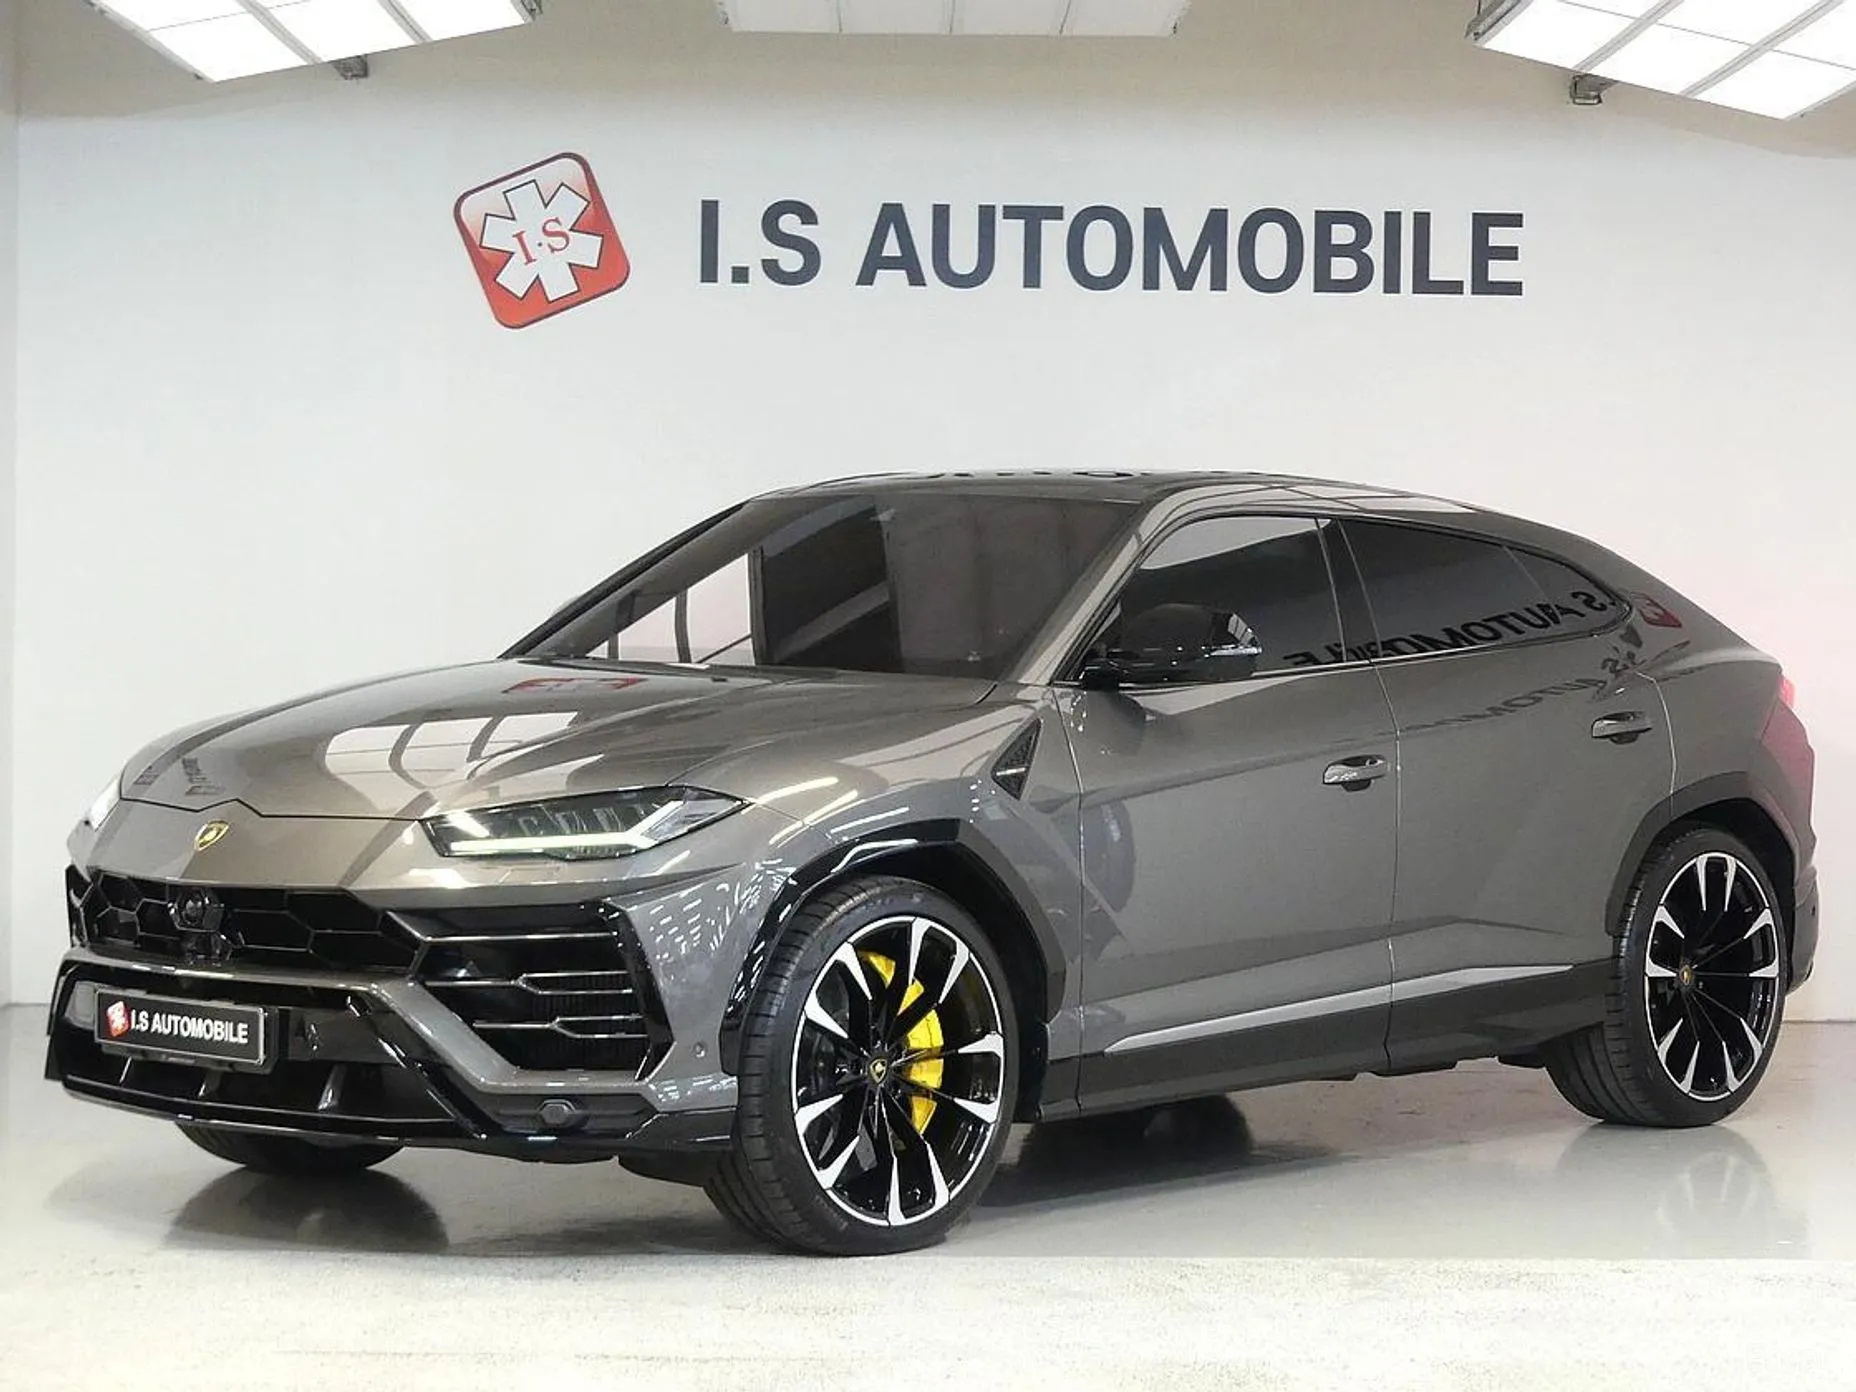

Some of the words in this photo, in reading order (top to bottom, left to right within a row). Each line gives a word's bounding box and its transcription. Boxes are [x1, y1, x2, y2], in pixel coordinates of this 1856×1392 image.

[699, 199, 822, 286] I.S
[855, 202, 1524, 297] AUTOMOBILE
[130, 1009, 149, 1032] I.S
[151, 1012, 249, 1044] AUTOMOBILE
